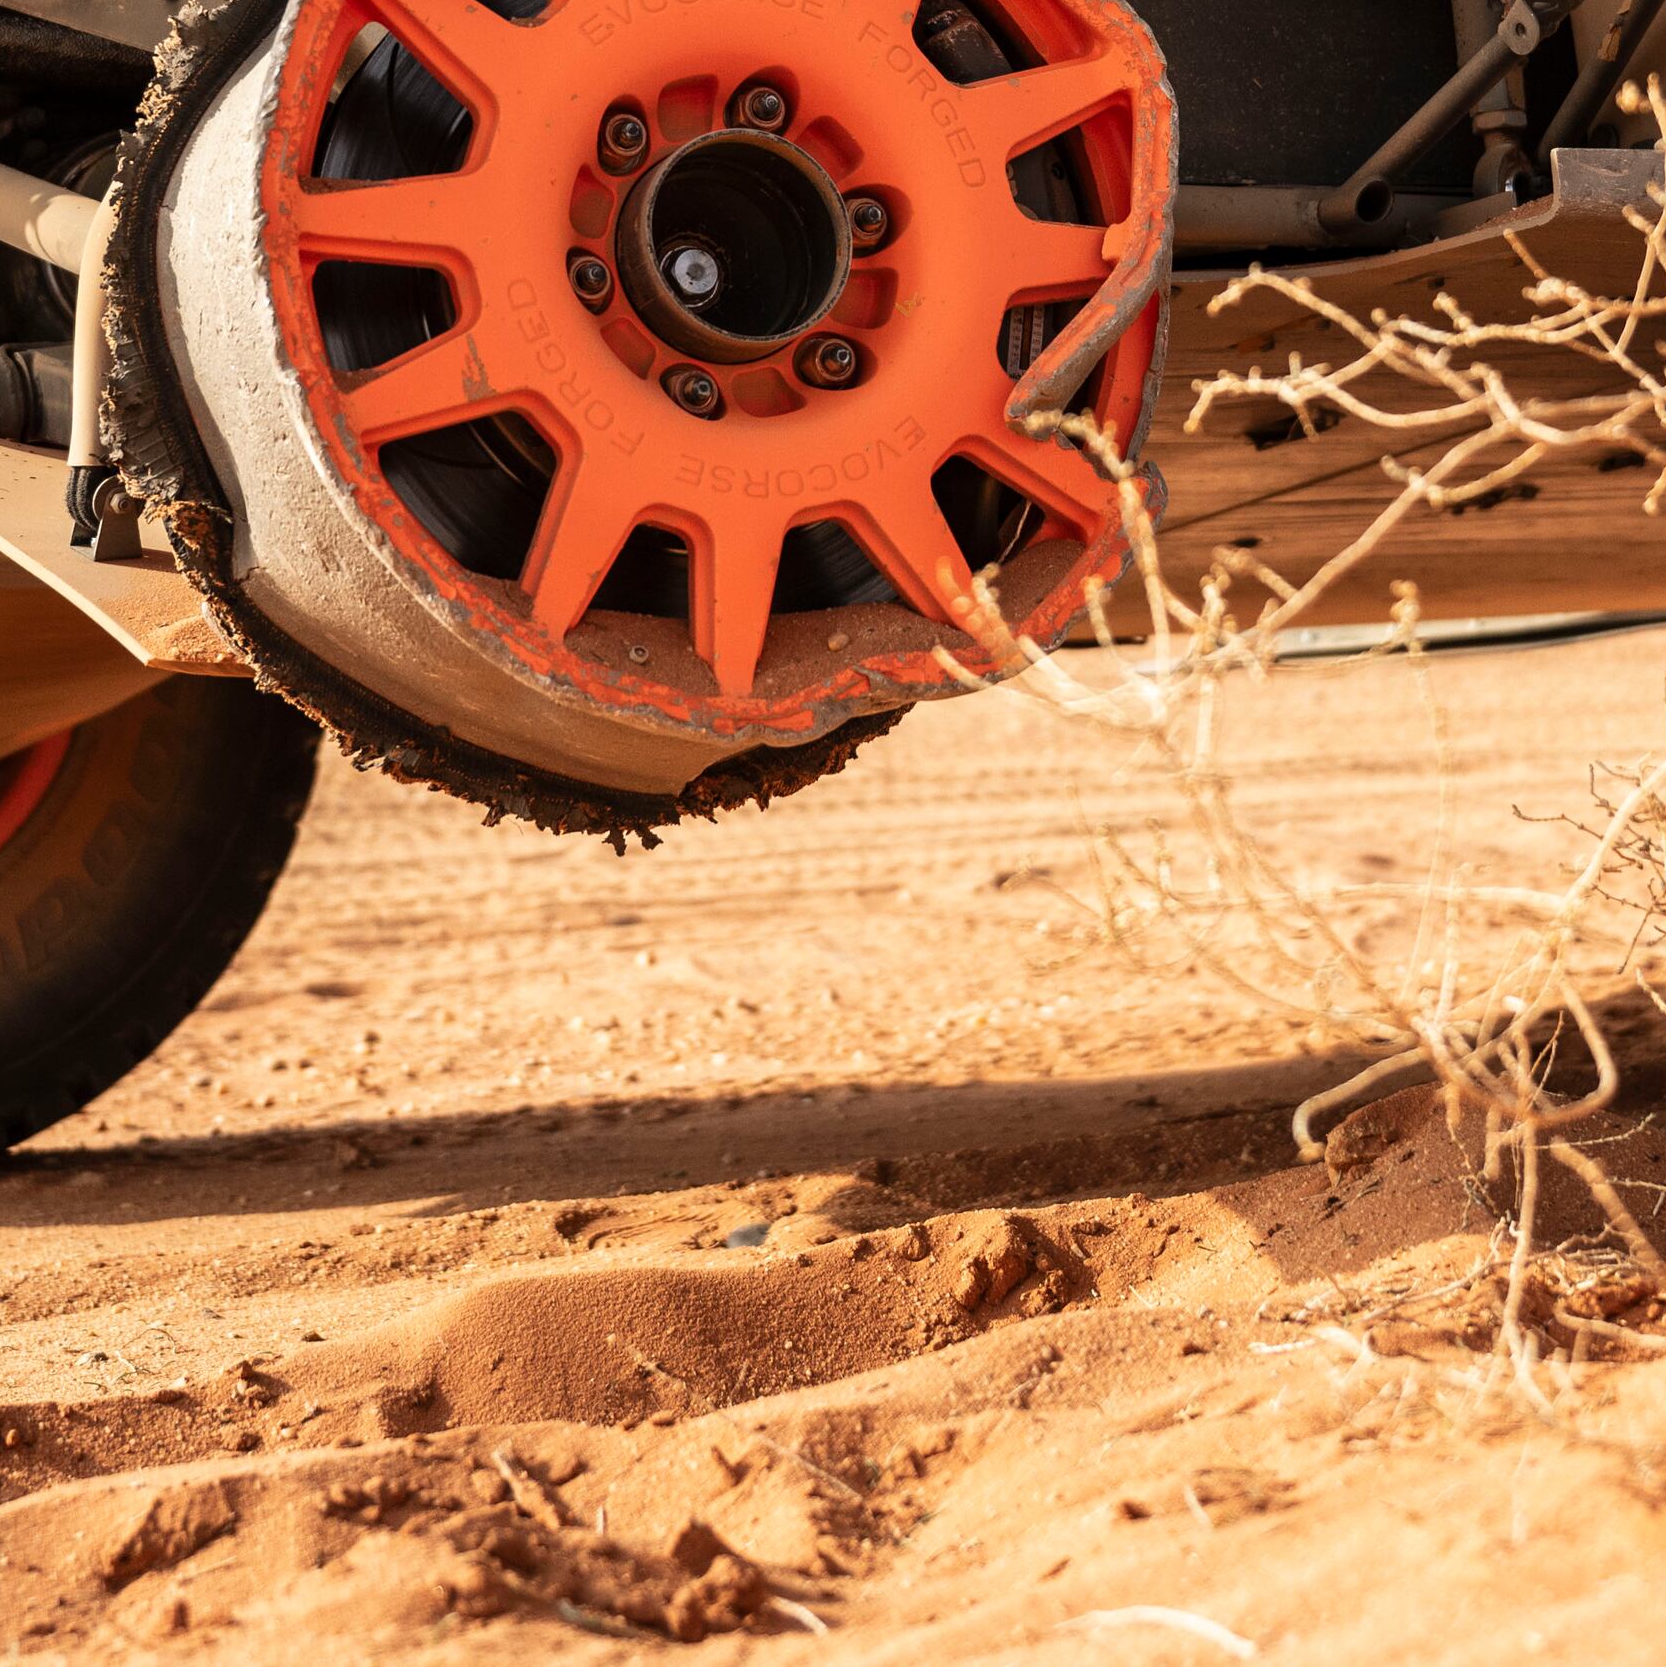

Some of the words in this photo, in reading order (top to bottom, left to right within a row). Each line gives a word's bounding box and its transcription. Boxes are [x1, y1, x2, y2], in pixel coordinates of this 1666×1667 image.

[856, 20, 988, 190] FORGED
[506, 278, 645, 457] FORGED
[674, 415, 928, 500] EVOCORSE
